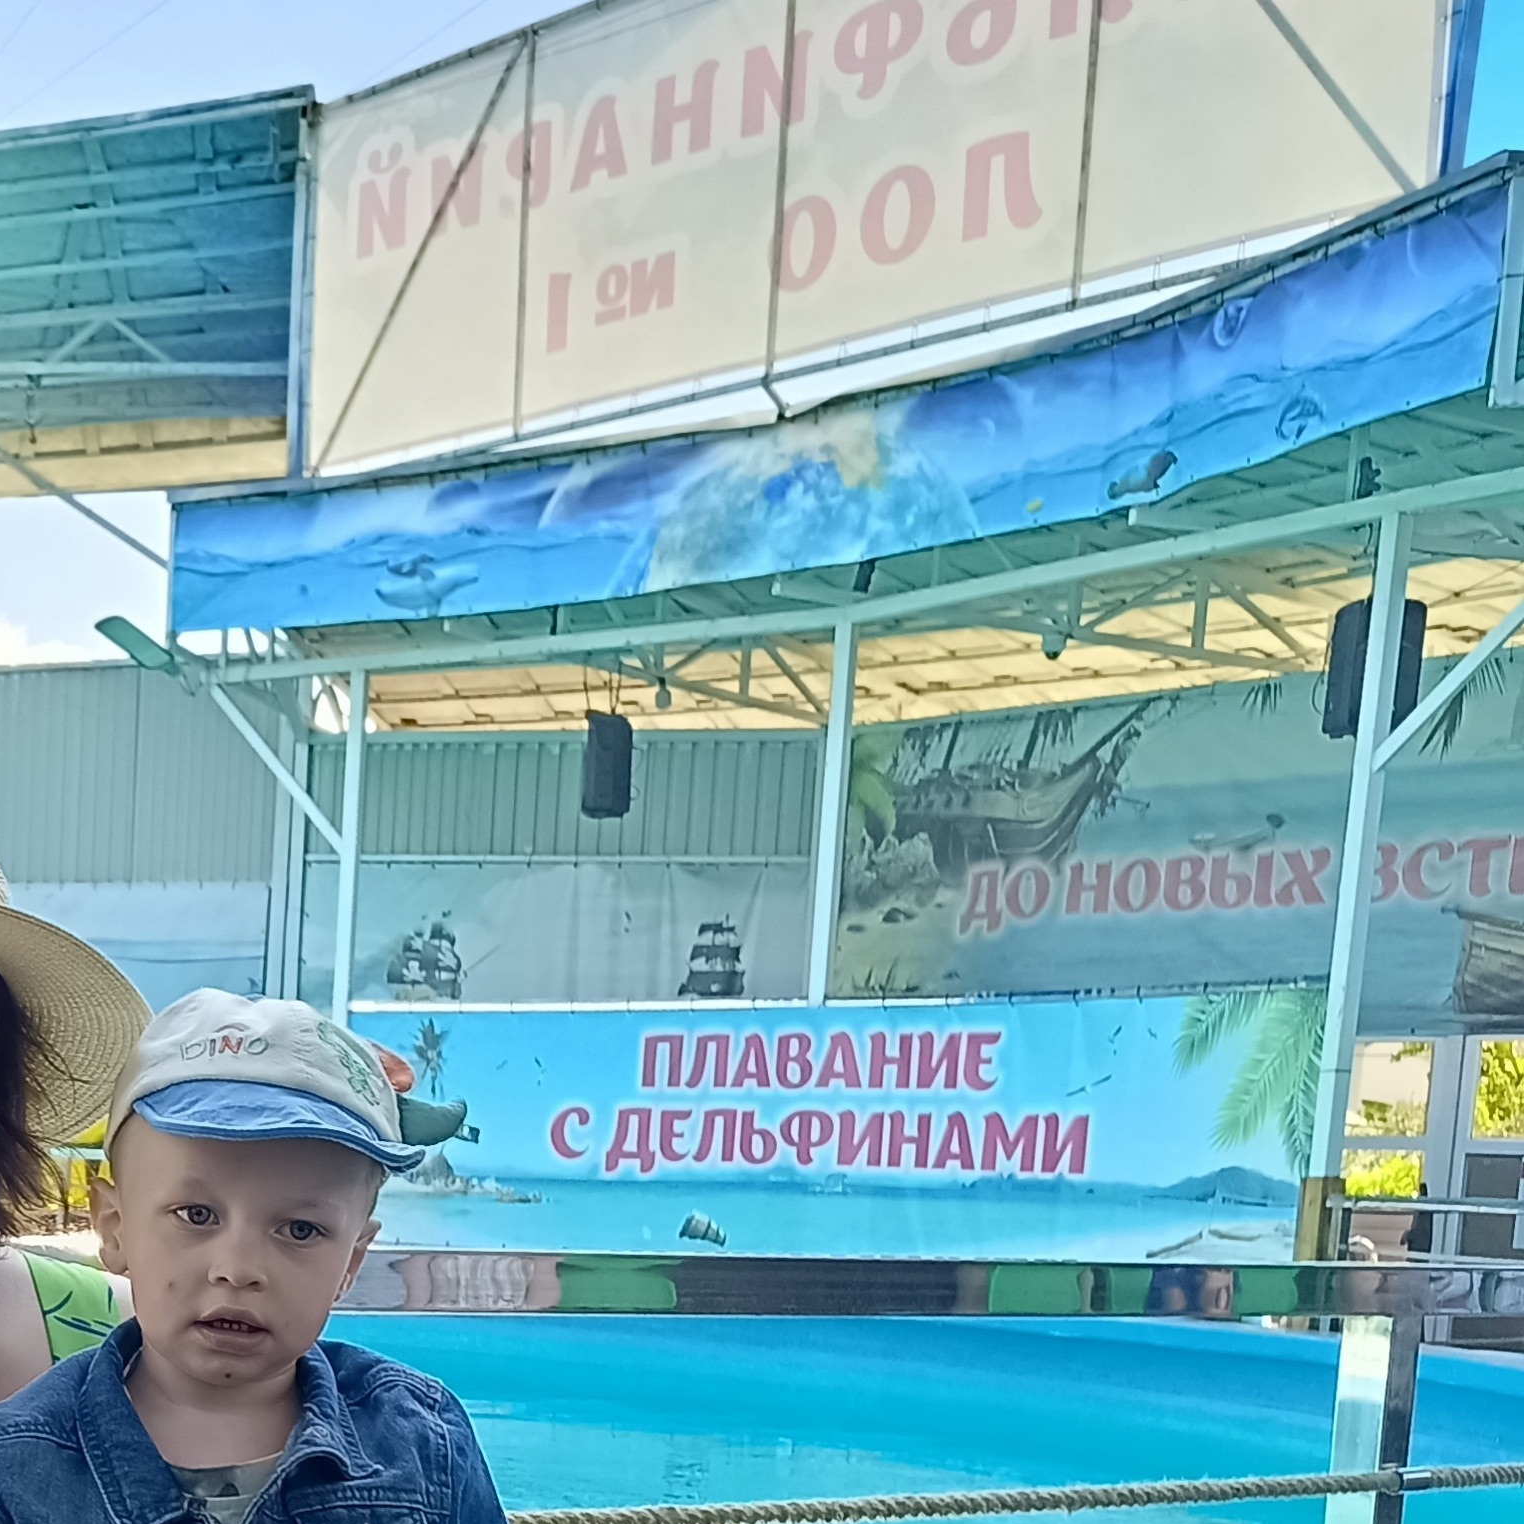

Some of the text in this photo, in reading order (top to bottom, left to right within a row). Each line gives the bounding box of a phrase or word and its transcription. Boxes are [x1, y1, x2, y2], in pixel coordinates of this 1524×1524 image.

[958, 859, 1051, 935] ДО
[1064, 846, 1332, 917] НОВЫХ
[180, 1034, 270, 1062] DINO
[640, 1031, 1002, 1090] ПЛАВАНИЕ
[550, 1108, 1090, 1175] С ДЕЛЬФИНАМИ
